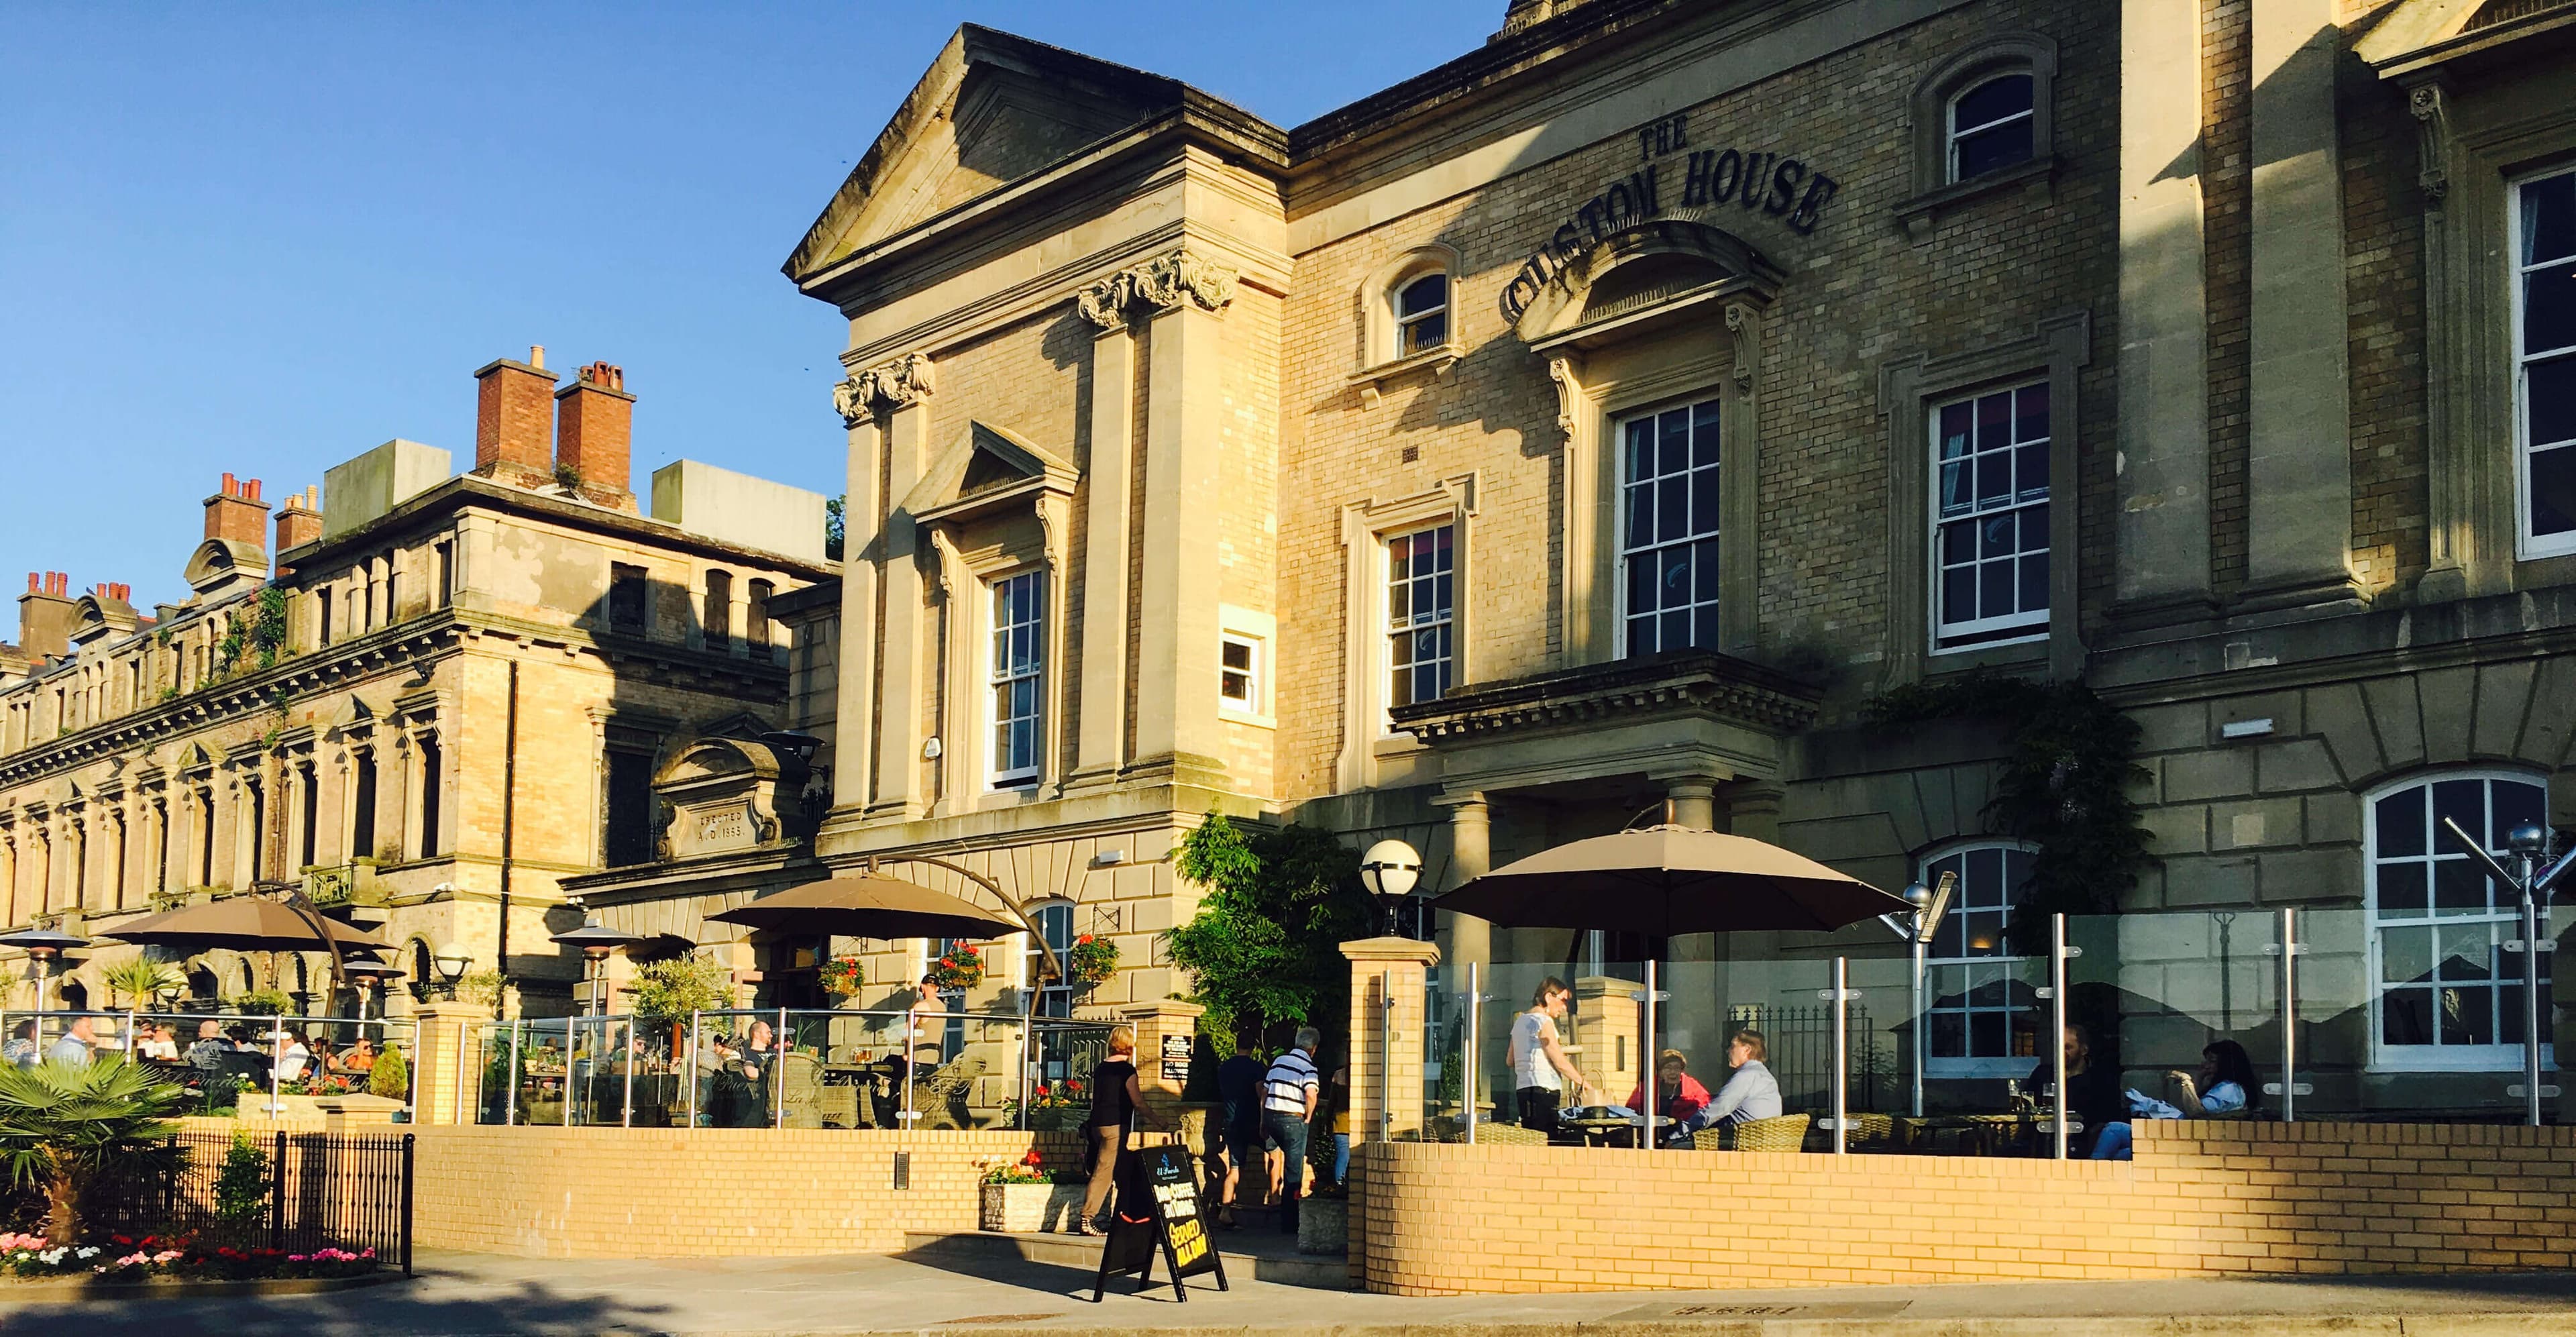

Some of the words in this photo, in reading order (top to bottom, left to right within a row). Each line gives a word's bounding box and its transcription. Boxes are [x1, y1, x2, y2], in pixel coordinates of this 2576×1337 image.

[1638, 114, 1688, 161] THE
[1499, 163, 1659, 325] CUSTOM
[1680, 149, 1839, 236] HOUSE
[700, 812, 741, 825] ERECTED
[1171, 1181, 1196, 1199] COFFEE
[1169, 1218, 1201, 1249] SERVED
[1177, 1243, 1191, 1268] ALL
[1190, 1233, 1208, 1259] DAY
